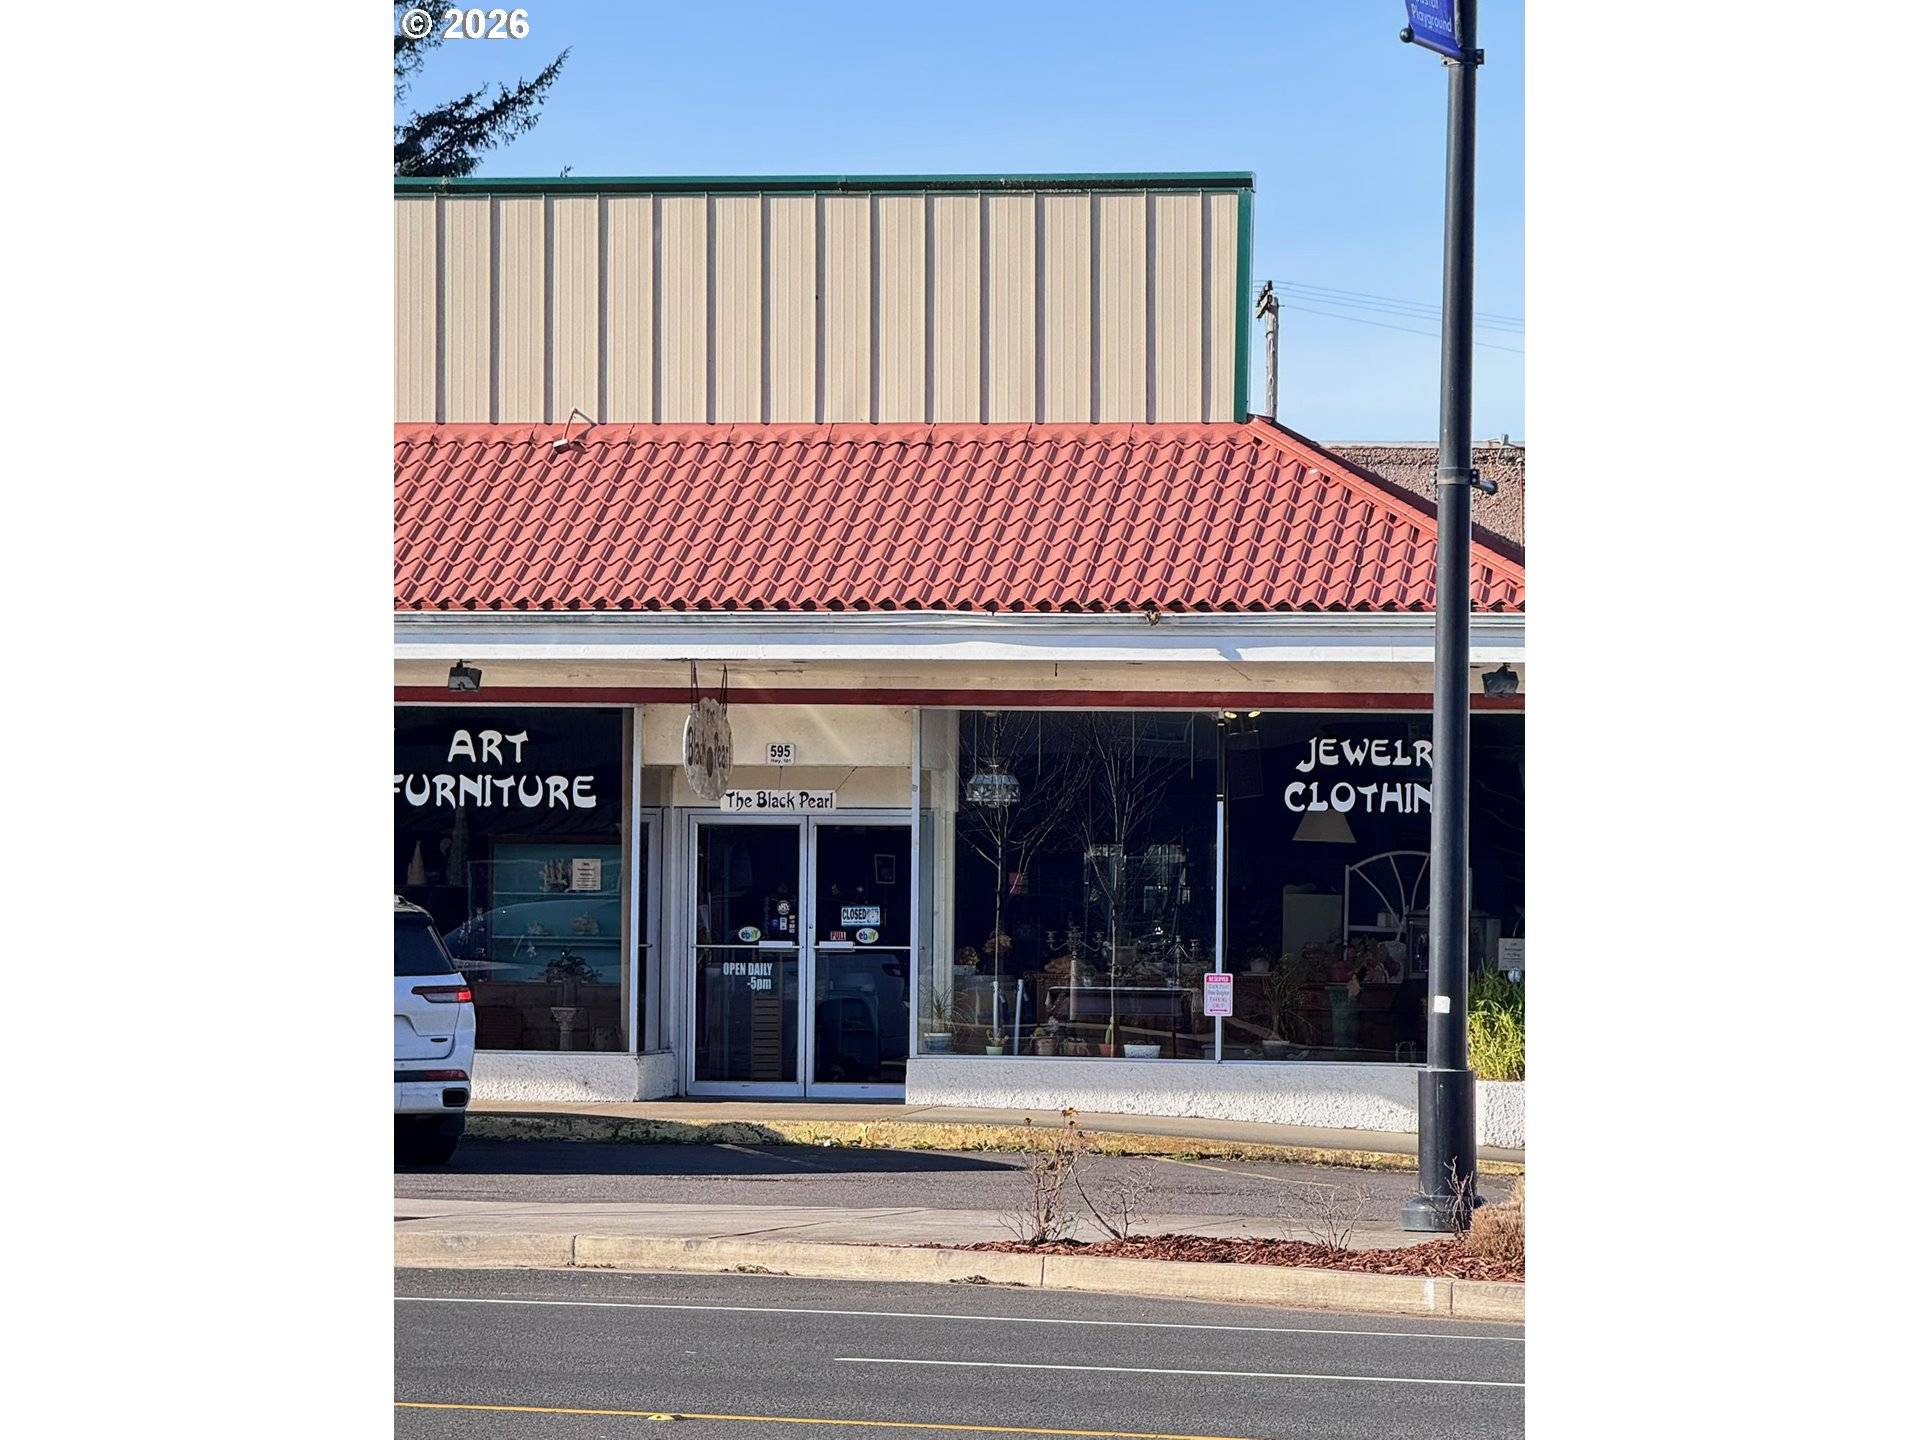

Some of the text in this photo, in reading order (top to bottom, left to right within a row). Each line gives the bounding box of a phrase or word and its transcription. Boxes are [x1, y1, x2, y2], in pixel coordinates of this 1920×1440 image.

[447, 729, 529, 765] ART
[770, 745, 791, 758] 595
[1295, 736, 1433, 773] JEWELR
[725, 790, 833, 811] The Black Pearl
[1284, 781, 1433, 813] CLOTHIN
[842, 908, 867, 921] CLOSED
[723, 962, 773, 976] OPEN DAILY
